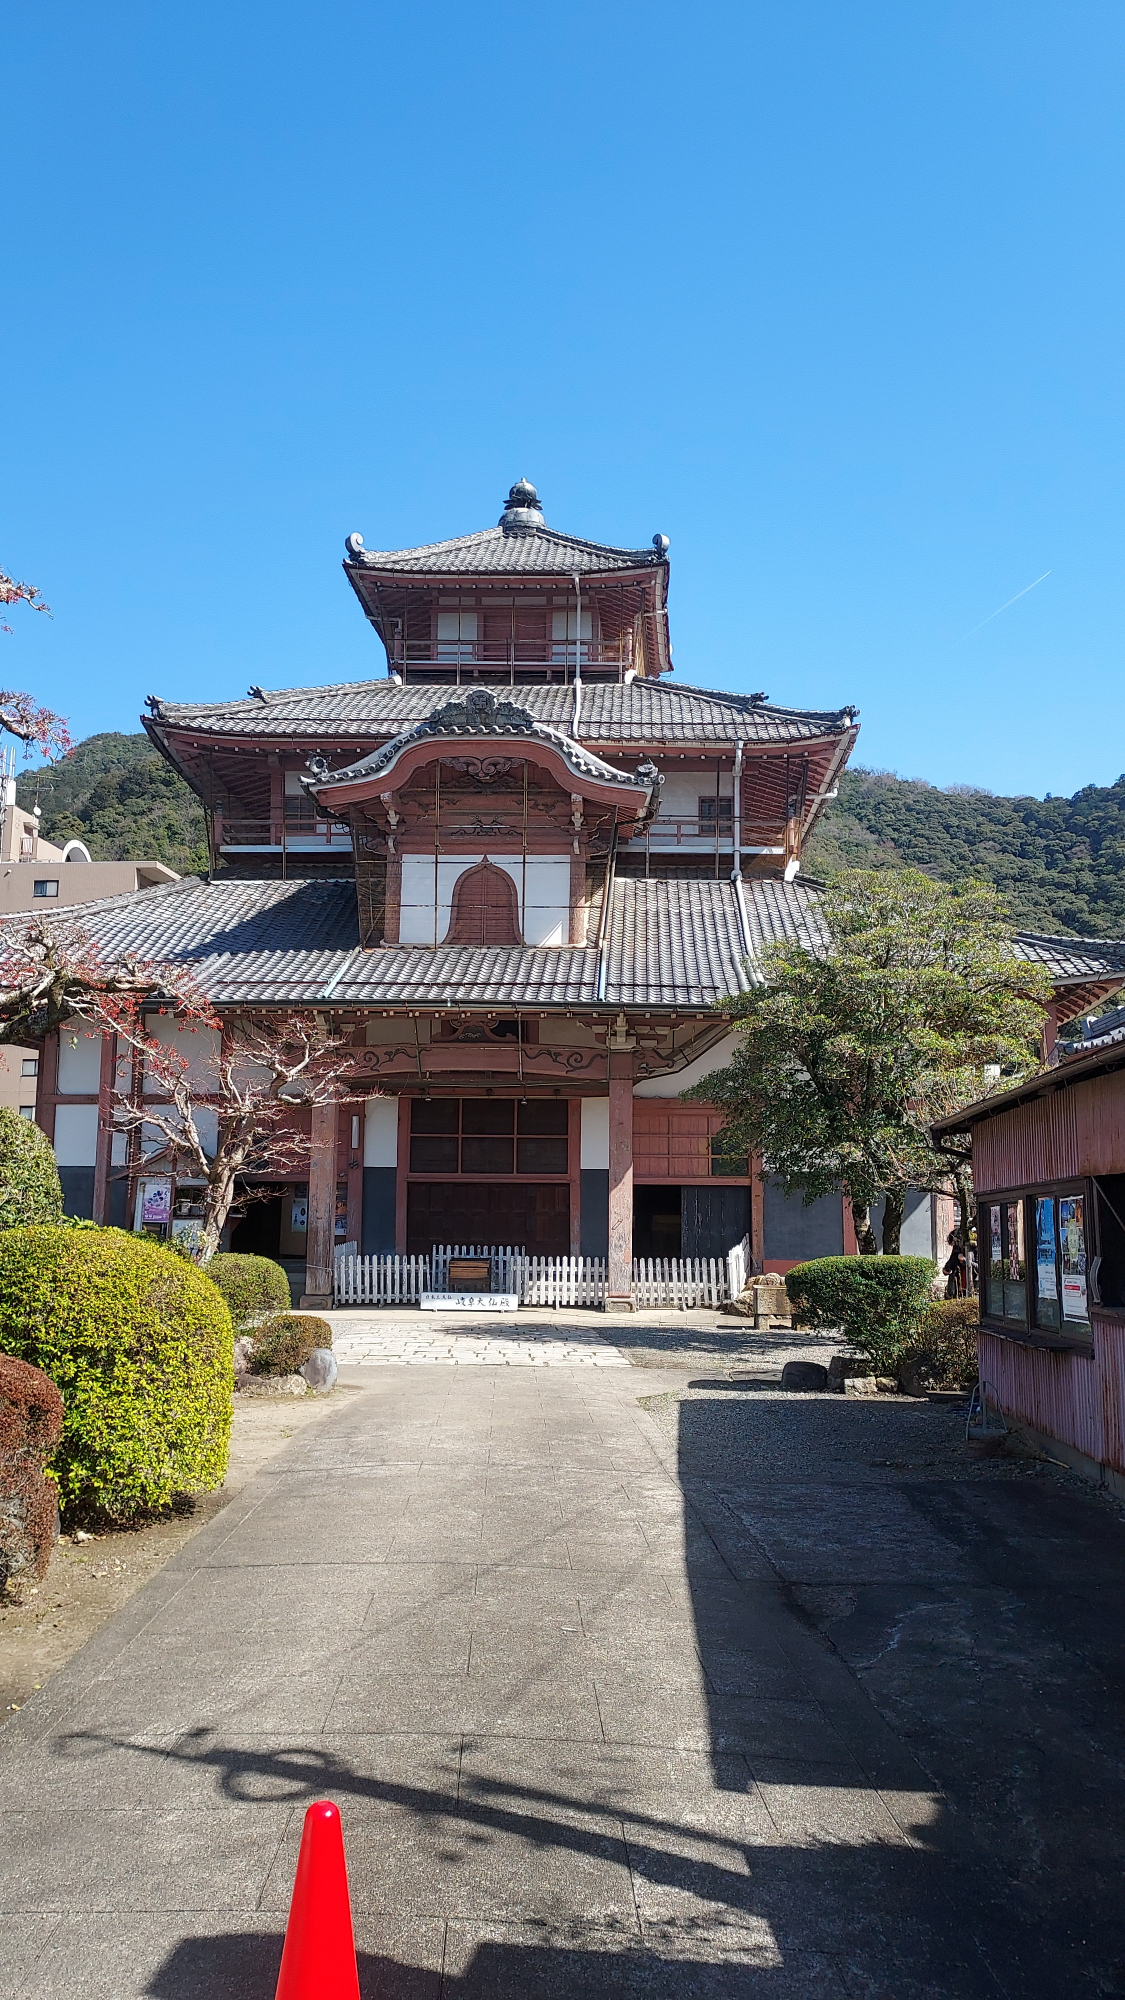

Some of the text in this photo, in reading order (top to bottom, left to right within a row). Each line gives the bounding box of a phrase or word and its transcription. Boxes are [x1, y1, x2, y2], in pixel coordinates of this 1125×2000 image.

[455, 1297, 510, 1307] 岐阜大仏殿
